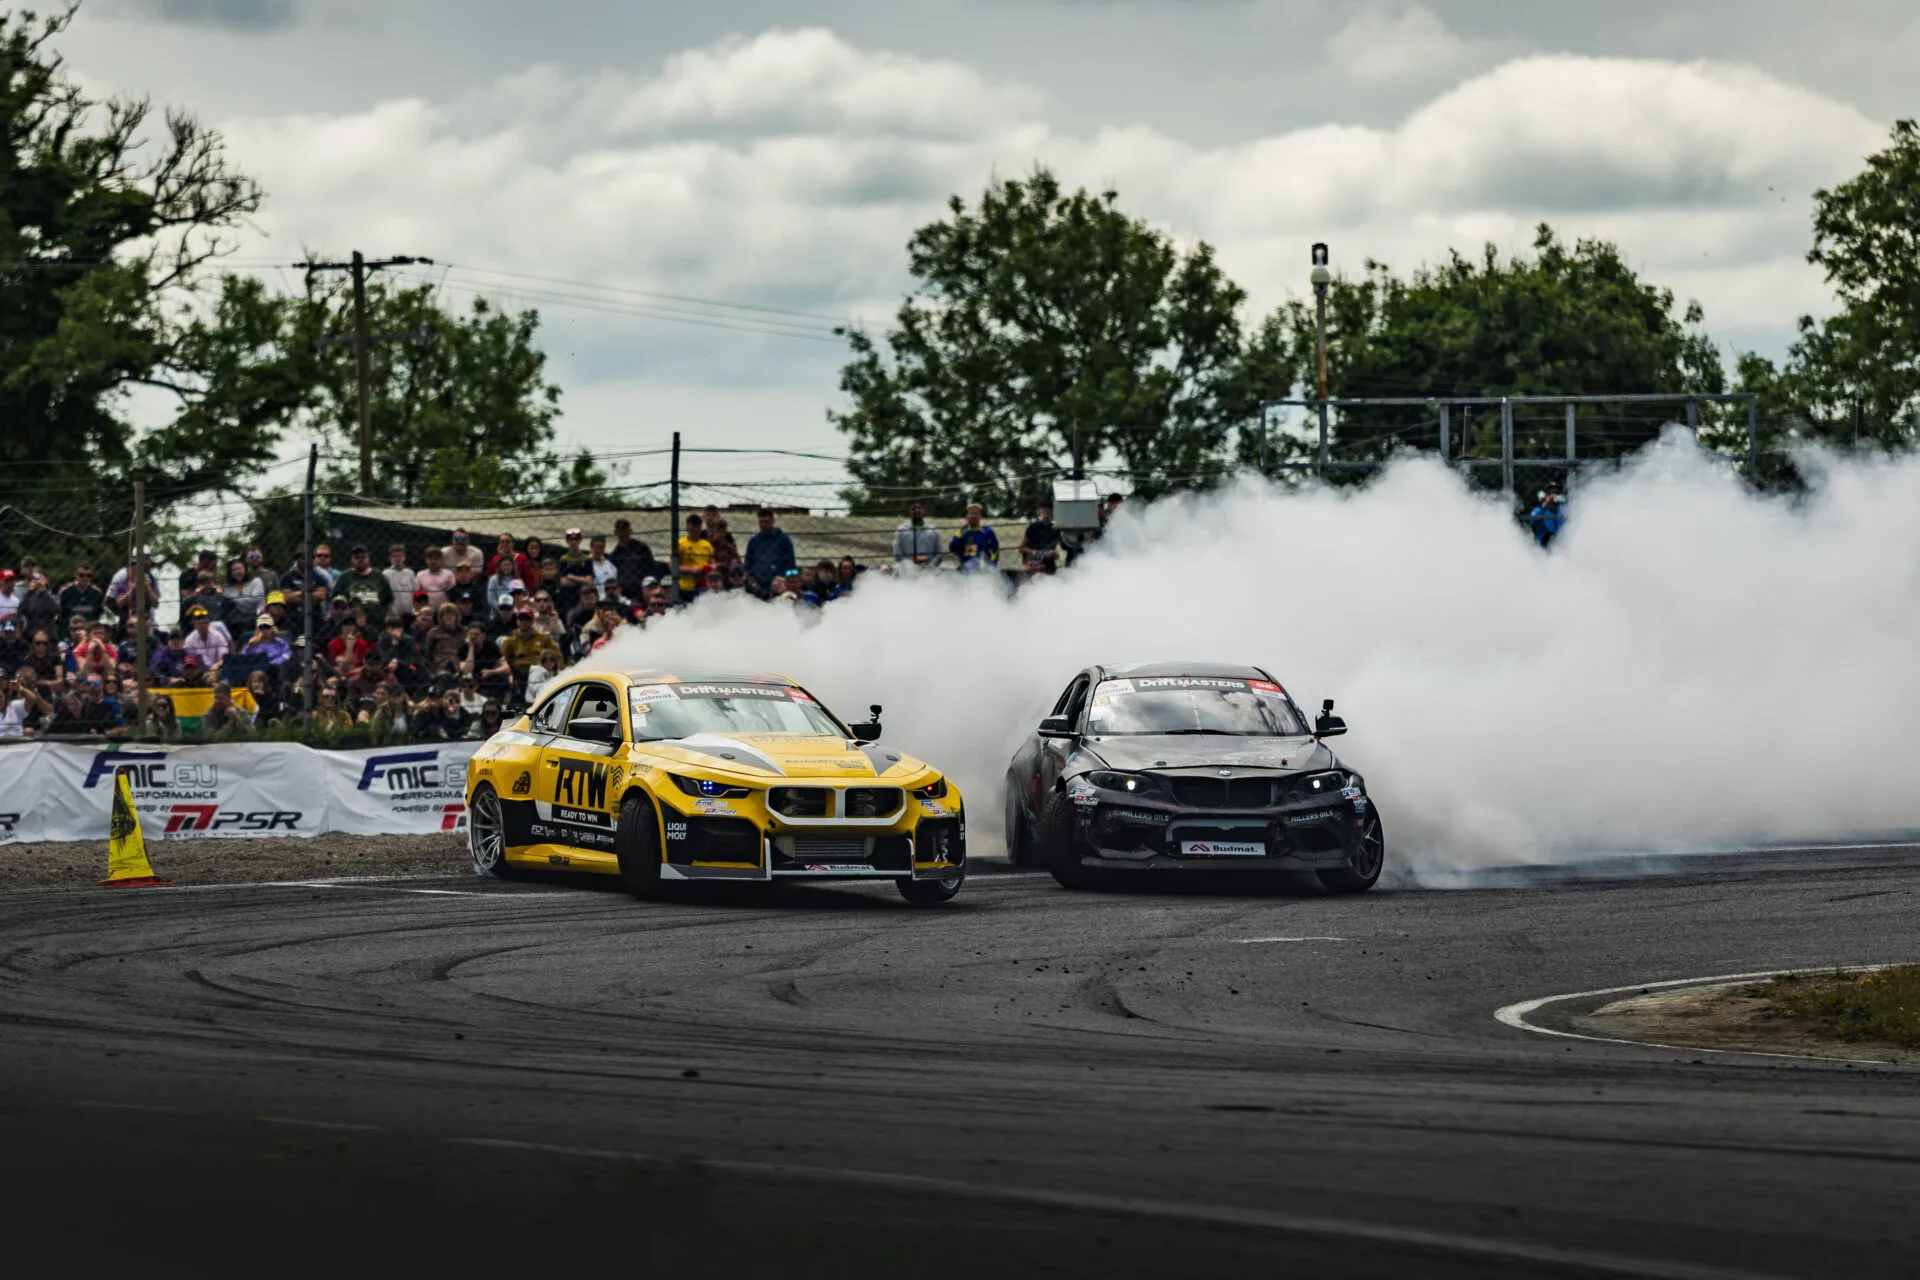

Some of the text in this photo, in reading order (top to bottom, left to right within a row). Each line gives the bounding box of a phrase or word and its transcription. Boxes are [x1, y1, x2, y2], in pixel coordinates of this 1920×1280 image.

[1139, 678, 1245, 688] Drift MASTERS
[679, 685, 718, 695] Drift
[718, 687, 785, 697] MASTERS
[357, 750, 467, 791] FMIC.E
[132, 790, 217, 800] RFORMANCE
[391, 790, 464, 801] PERFORMA
[212, 811, 303, 831] PSR
[560, 808, 598, 824] READY TO WIN
[1290, 809, 1334, 823] MILLERS OILS
[667, 822, 687, 831] LIQUI
[666, 832, 687, 841] MOLY
[1213, 845, 1258, 853] Budmat.
